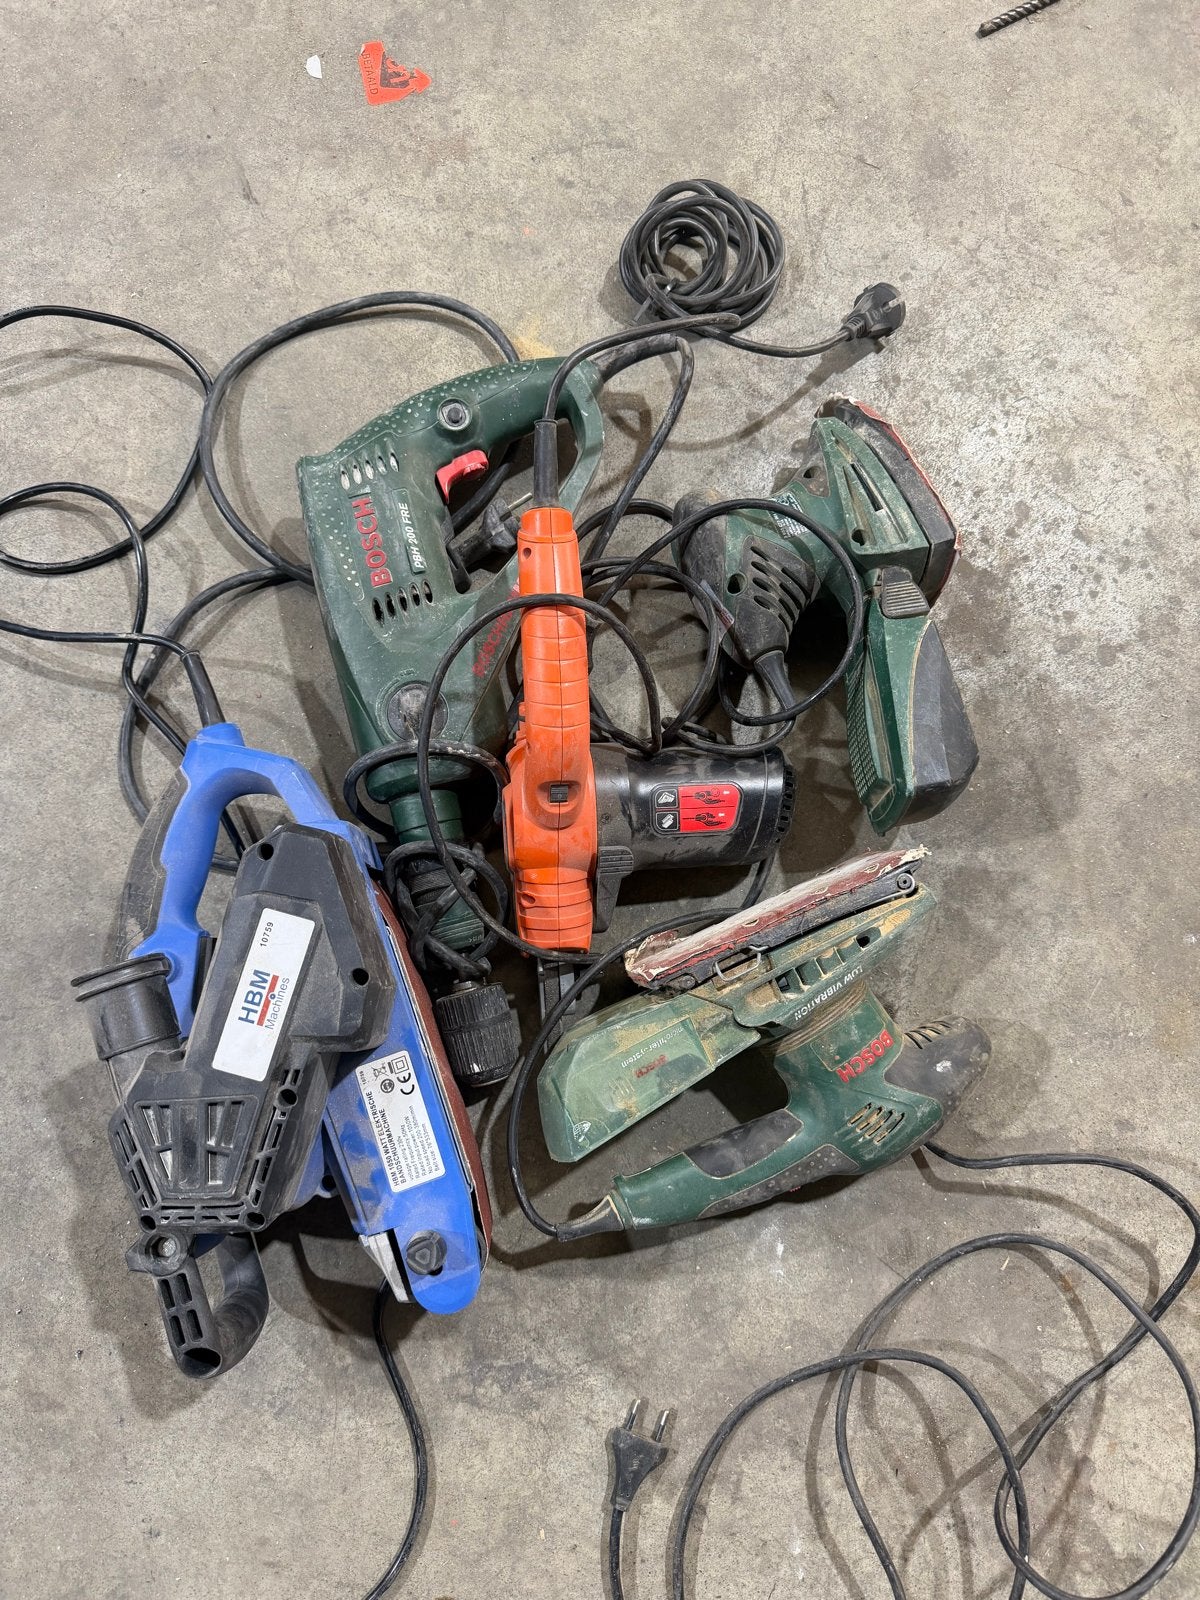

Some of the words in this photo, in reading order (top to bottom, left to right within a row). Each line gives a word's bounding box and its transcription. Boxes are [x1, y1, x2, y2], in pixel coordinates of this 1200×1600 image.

[361, 52, 379, 95] BETAALD
[398, 502, 412, 525] FRE
[351, 496, 393, 588] BOSCH
[404, 526, 419, 545] 200
[410, 545, 425, 569] PBH
[260, 921, 274, 948] 10759
[844, 965, 864, 985] LOW
[238, 969, 271, 1025] HBM
[264, 977, 291, 1030] Machines
[794, 982, 843, 1021] VIBRATION
[836, 1029, 895, 1084] BOSCH
[365, 1090, 385, 1137] ELEKTRISCHE
[378, 1107, 407, 1184] BANDSCHUURMACHINE
[379, 1136, 391, 1156] WATT
[385, 1155, 395, 1171] 1050
[390, 1170, 400, 1187] HBM
